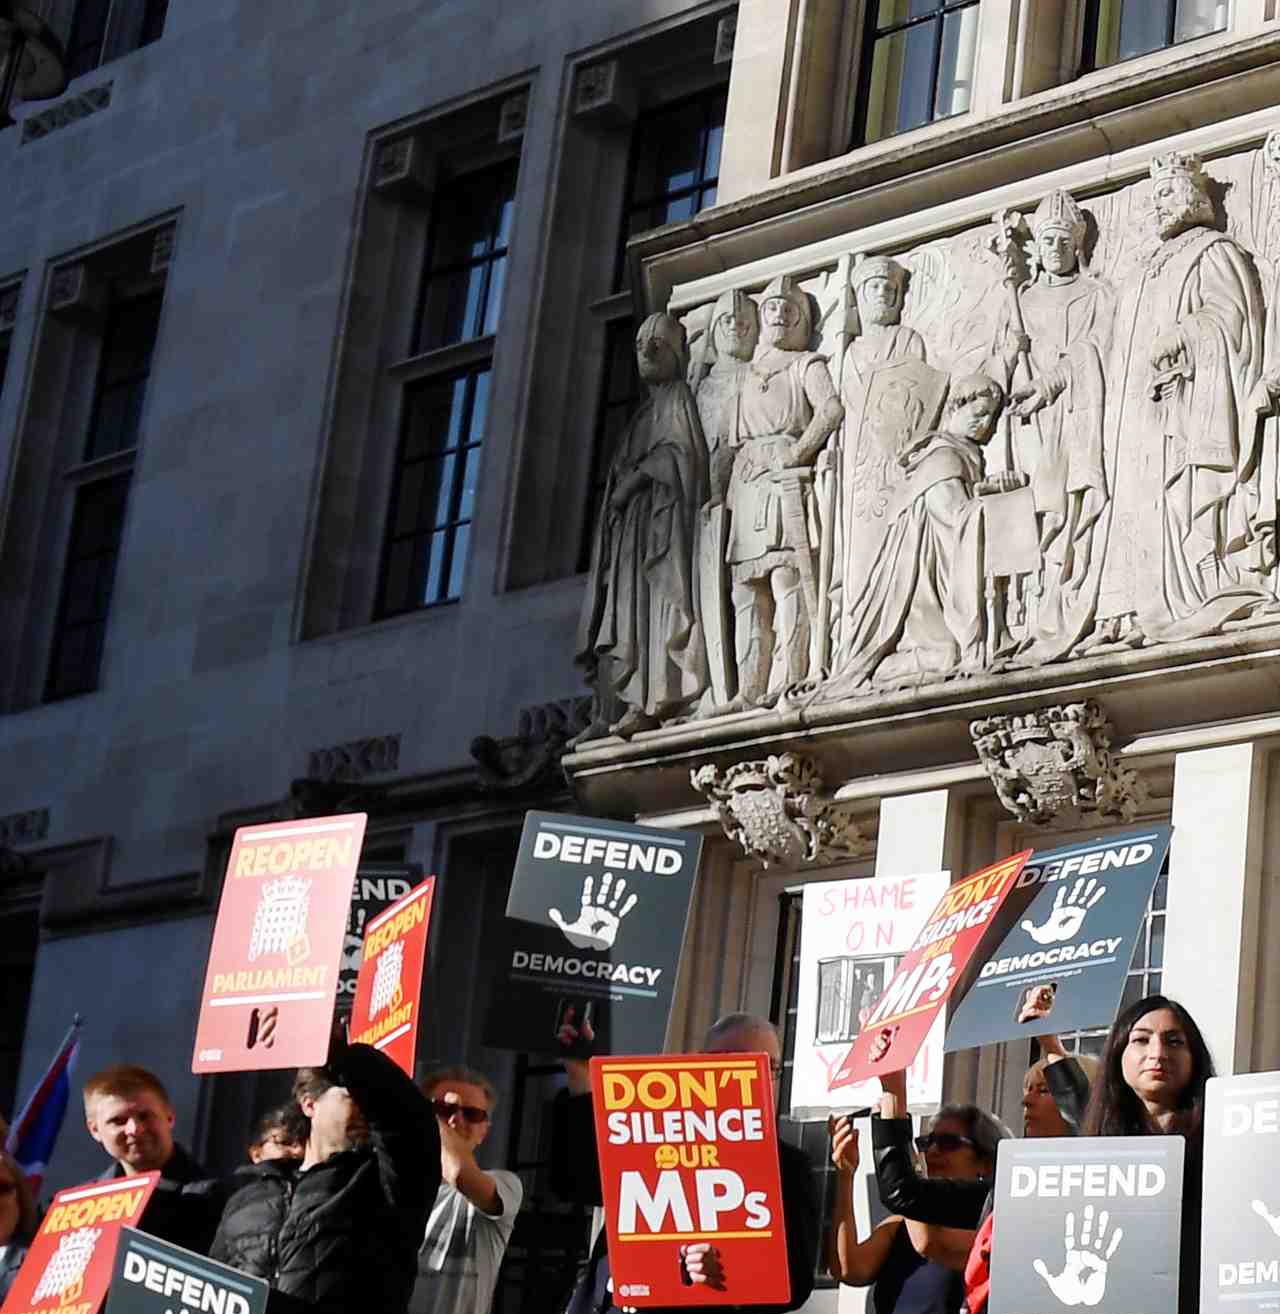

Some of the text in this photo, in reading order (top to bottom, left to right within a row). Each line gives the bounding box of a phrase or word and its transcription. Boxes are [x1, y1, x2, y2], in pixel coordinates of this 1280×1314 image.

[235, 836, 352, 879] REOPEN
[533, 832, 683, 875] DEFEND
[1016, 844, 1152, 888] DEFEND
[818, 879, 915, 916] SHAME
[932, 863, 1018, 922] DON'T
[364, 897, 426, 961] REOPEN
[847, 920, 894, 951] ON
[912, 896, 999, 950] SILENCE
[512, 950, 662, 986] DEMOCRACY
[980, 937, 1123, 977] DEMOCRACY
[213, 965, 328, 993] PARLIAMENT
[866, 953, 956, 1026] MPs
[602, 1070, 758, 1110] DON'T
[607, 1108, 764, 1144] SILENCE
[618, 1169, 772, 1233] MPs
[1010, 1164, 1166, 1198] DEFEND
[44, 1190, 144, 1235] REOPEN
